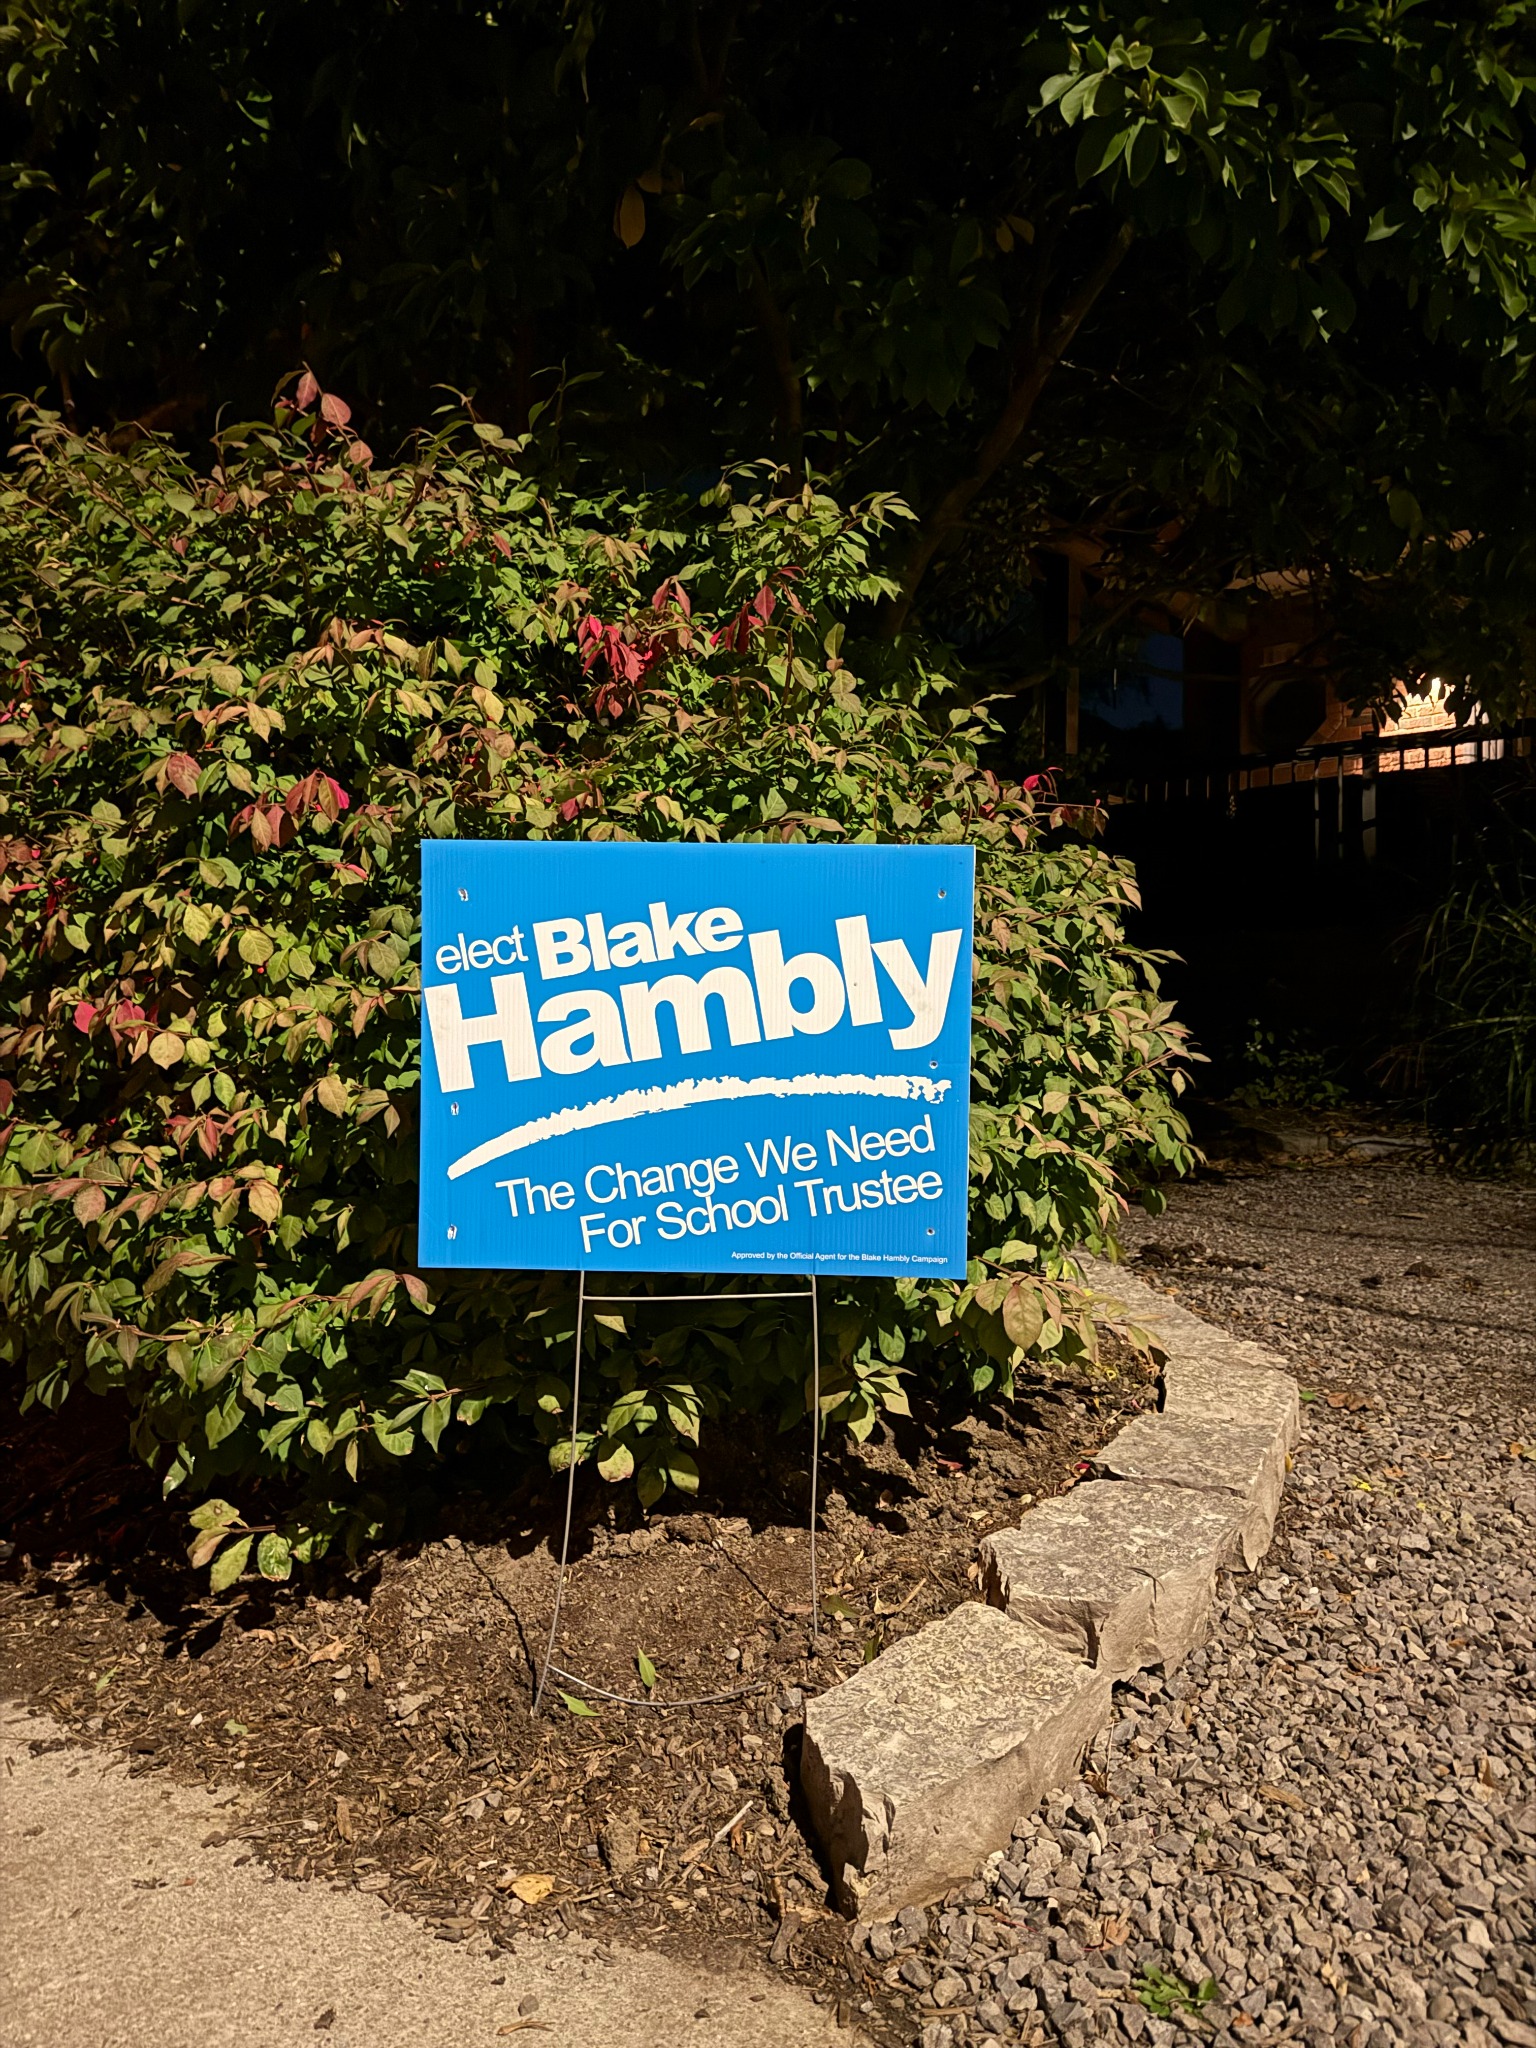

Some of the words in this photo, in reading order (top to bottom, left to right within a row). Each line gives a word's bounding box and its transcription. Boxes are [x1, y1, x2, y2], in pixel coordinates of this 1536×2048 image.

[435, 925, 528, 975] elect
[533, 902, 744, 980] Blake
[424, 914, 963, 1094] Hambly
[496, 1178, 575, 1217] The
[584, 1155, 740, 1204] Change
[745, 1135, 818, 1177] We
[826, 1114, 936, 1166] Need
[580, 1213, 647, 1253] For
[656, 1184, 788, 1239] School
[794, 1170, 944, 1216] Trustee
[731, 1251, 765, 1260] Approved
[766, 1252, 776, 1260] by
[777, 1252, 789, 1260] the
[790, 1252, 814, 1260] Official
[815, 1253, 836, 1262] Agent
[861, 1254, 882, 1262] Blake
[883, 1255, 910, 1263] Hambly
[911, 1255, 948, 1264] Campaign
